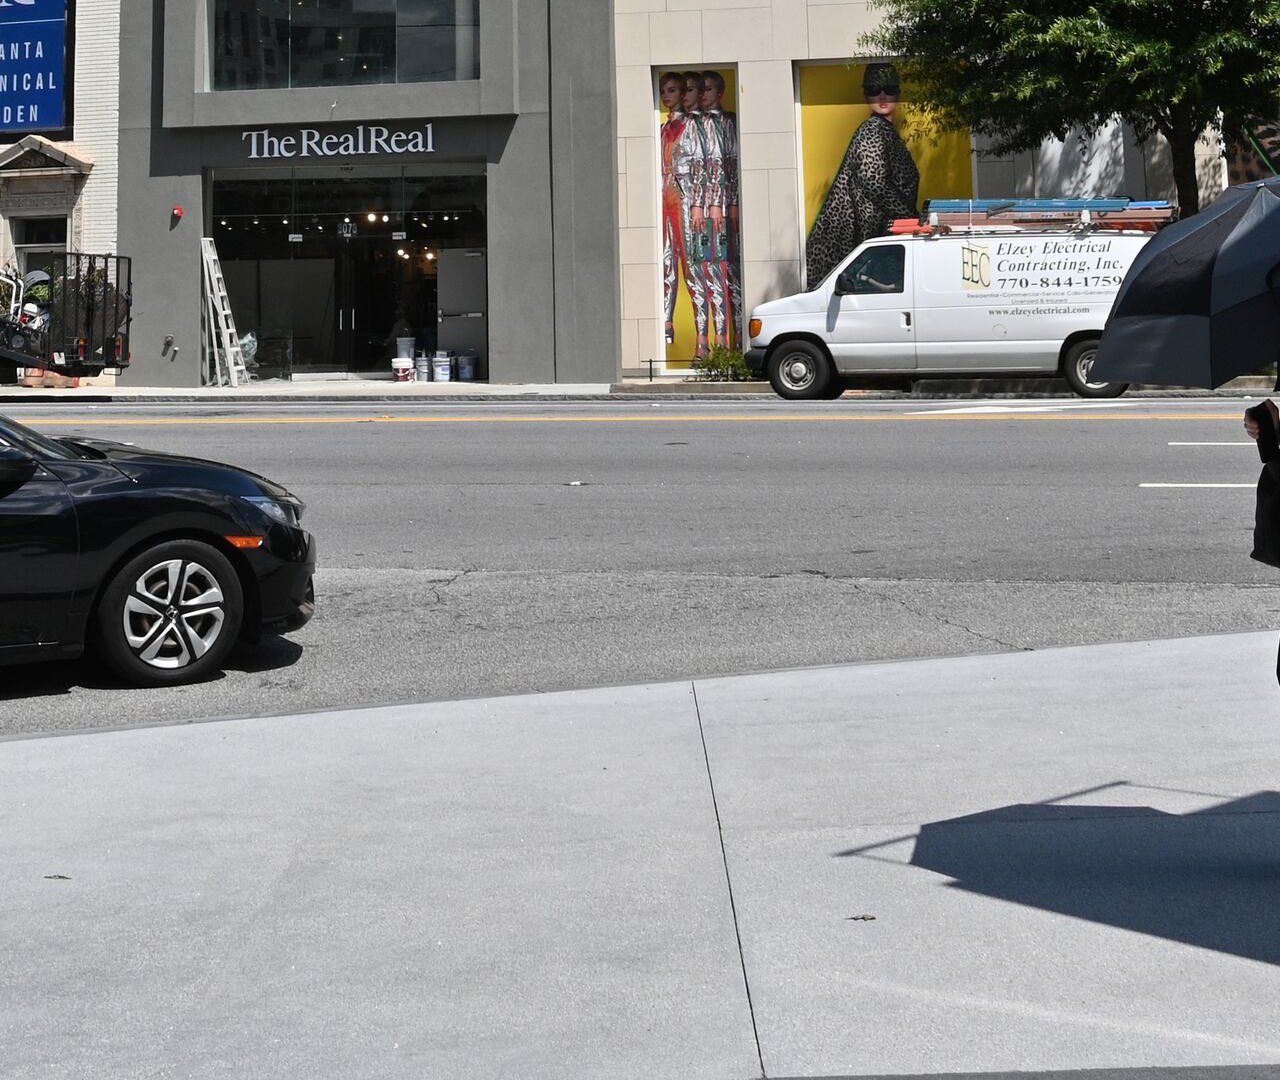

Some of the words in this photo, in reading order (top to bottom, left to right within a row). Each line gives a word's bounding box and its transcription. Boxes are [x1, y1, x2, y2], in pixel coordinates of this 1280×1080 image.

[961, 246, 991, 288] EEC
[997, 242, 1037, 259] Elzey
[1042, 240, 1112, 255] Electrical
[1096, 257, 1124, 270] Inc.
[997, 276, 1123, 289] 770-844-1759
[988, 306, 1090, 317] www.elzeyelectrical.com
